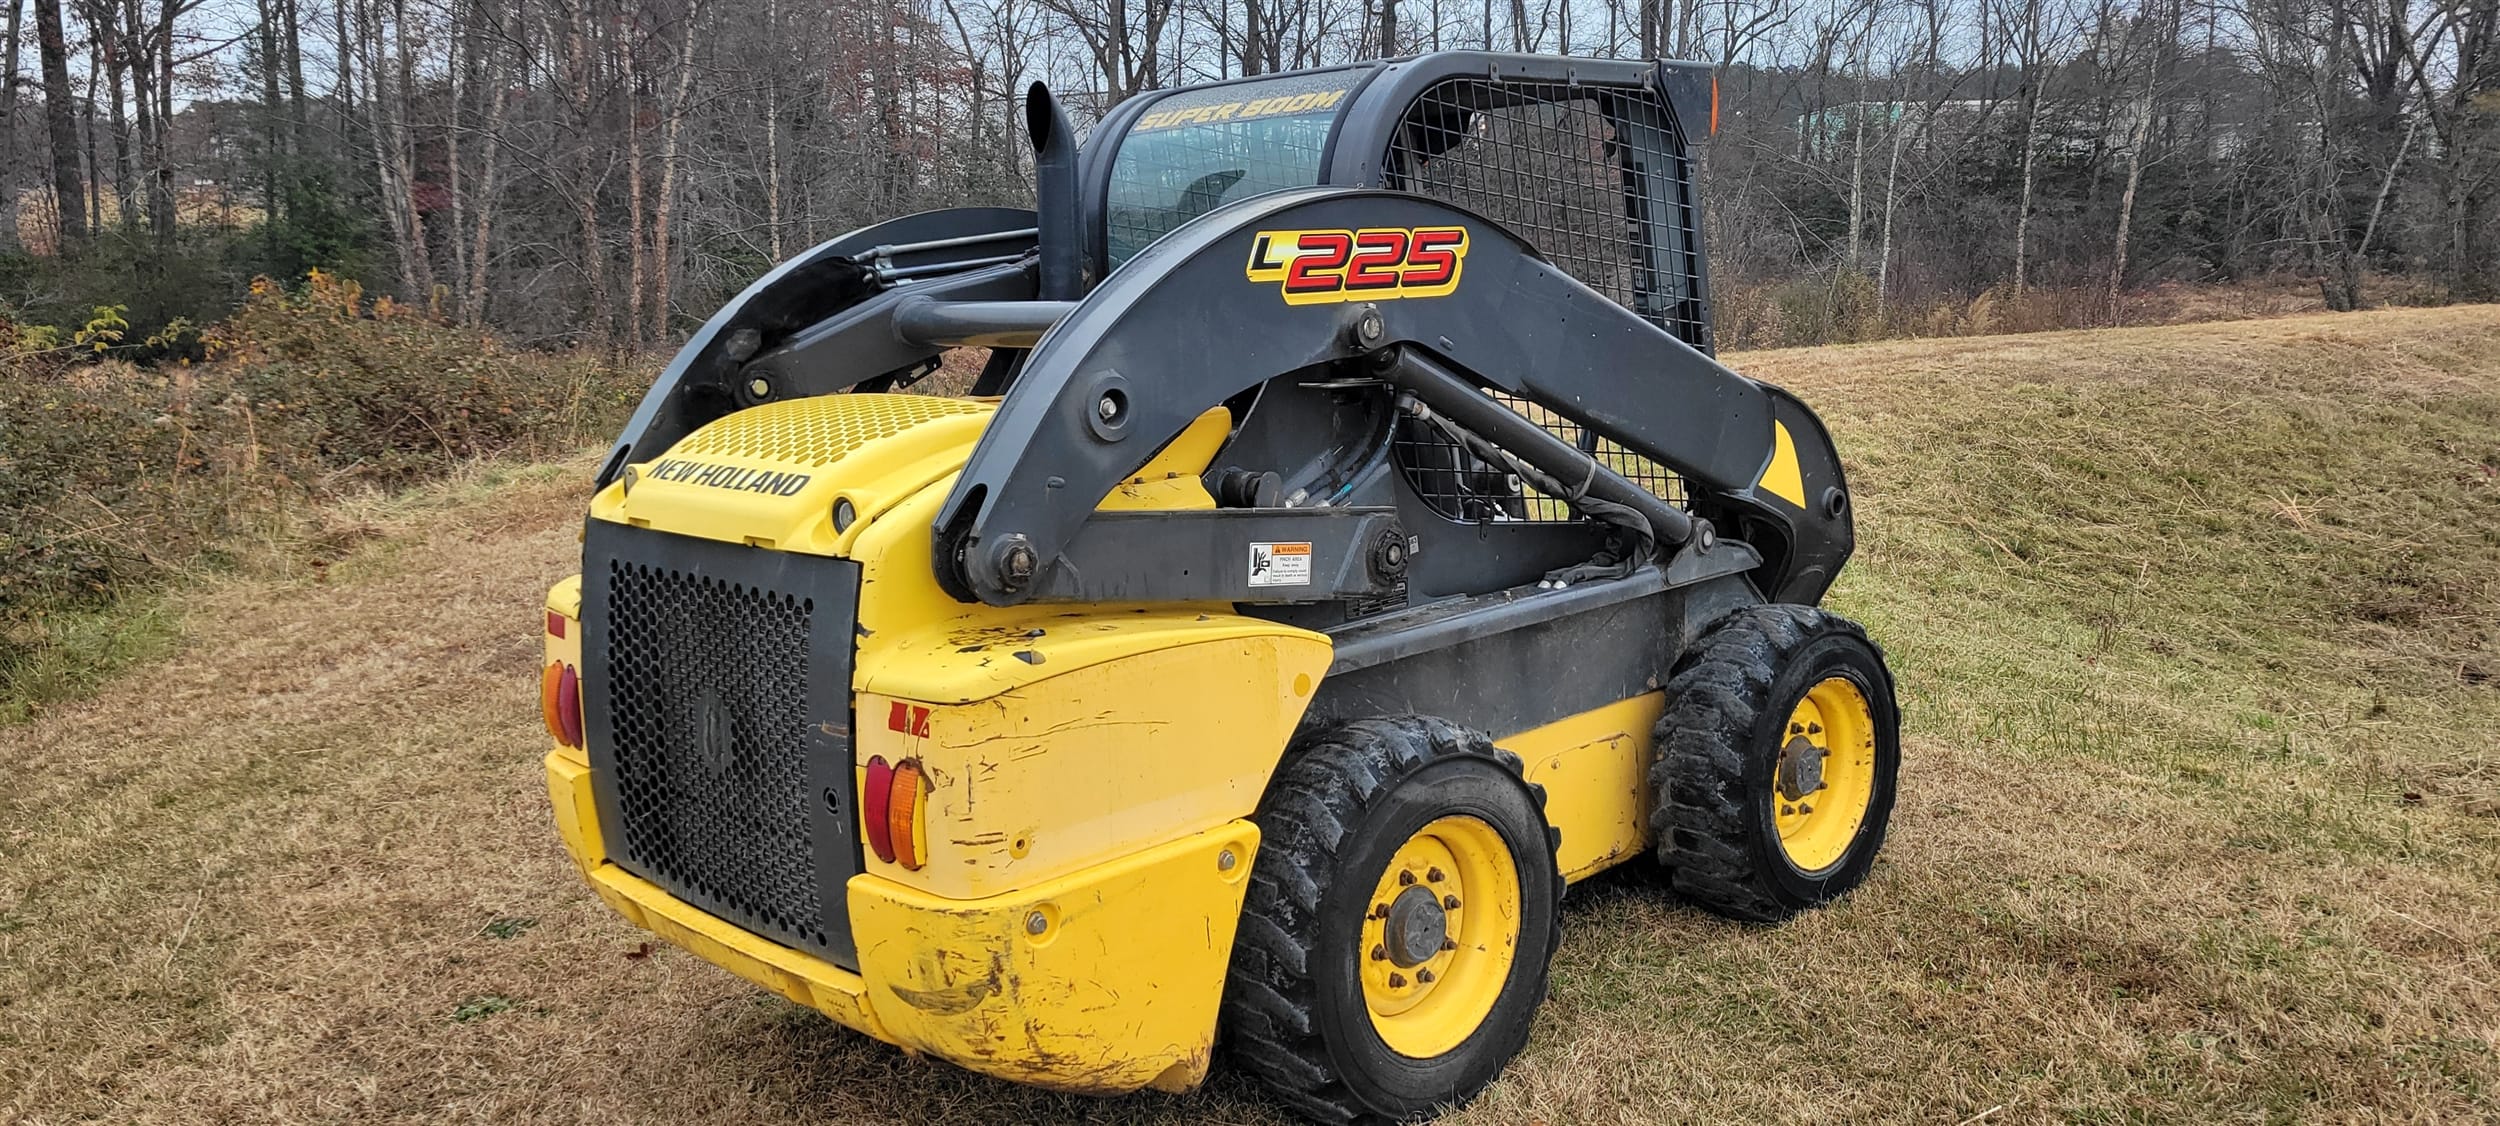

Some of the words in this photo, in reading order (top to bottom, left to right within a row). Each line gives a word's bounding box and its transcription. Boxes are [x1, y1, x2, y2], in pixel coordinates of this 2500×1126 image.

[1134, 103, 1241, 131] SUPER
[1240, 89, 1346, 117] BOOM
[1250, 231, 1465, 294] L225
[646, 459, 702, 482] NEW
[692, 464, 811, 496] HOLLAND
[1281, 545, 1308, 553] WARNING
